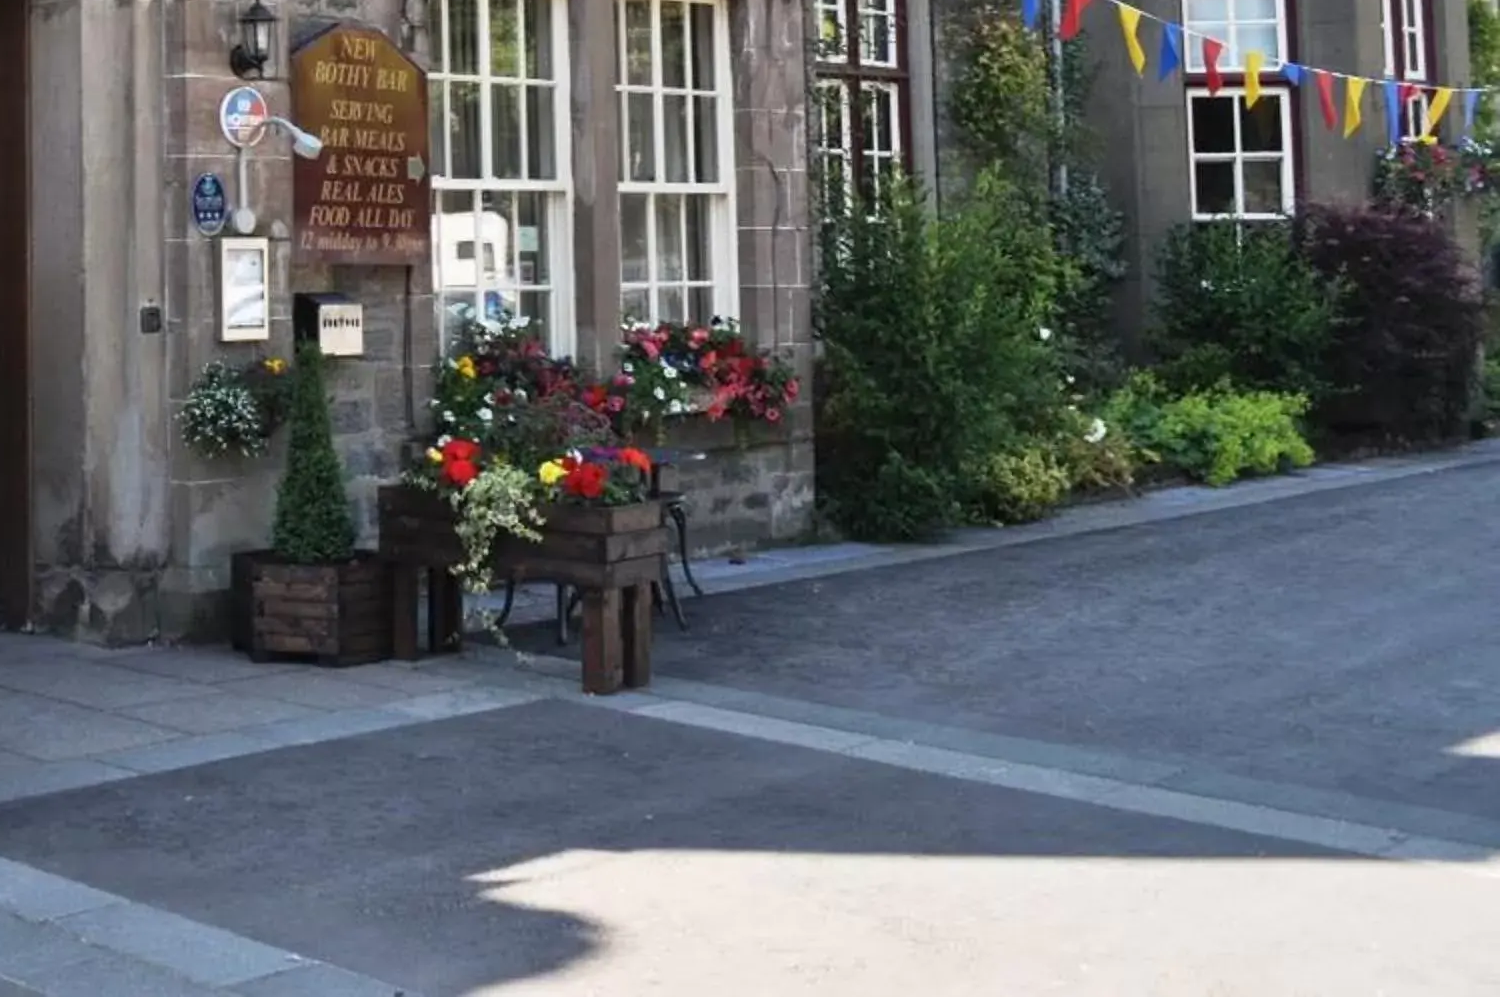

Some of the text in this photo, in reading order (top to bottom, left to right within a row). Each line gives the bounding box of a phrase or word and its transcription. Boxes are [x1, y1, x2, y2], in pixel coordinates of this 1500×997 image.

[340, 33, 376, 62] NEW
[315, 60, 408, 93] BOTHY BAR
[329, 99, 394, 124] SERVING
[320, 125, 407, 152] BAR MEALS
[325, 154, 400, 177] & SNACKS
[321, 180, 405, 204] REAL ALES
[309, 205, 416, 229] FOOD ALL DAY
[317, 231, 362, 256] midday
